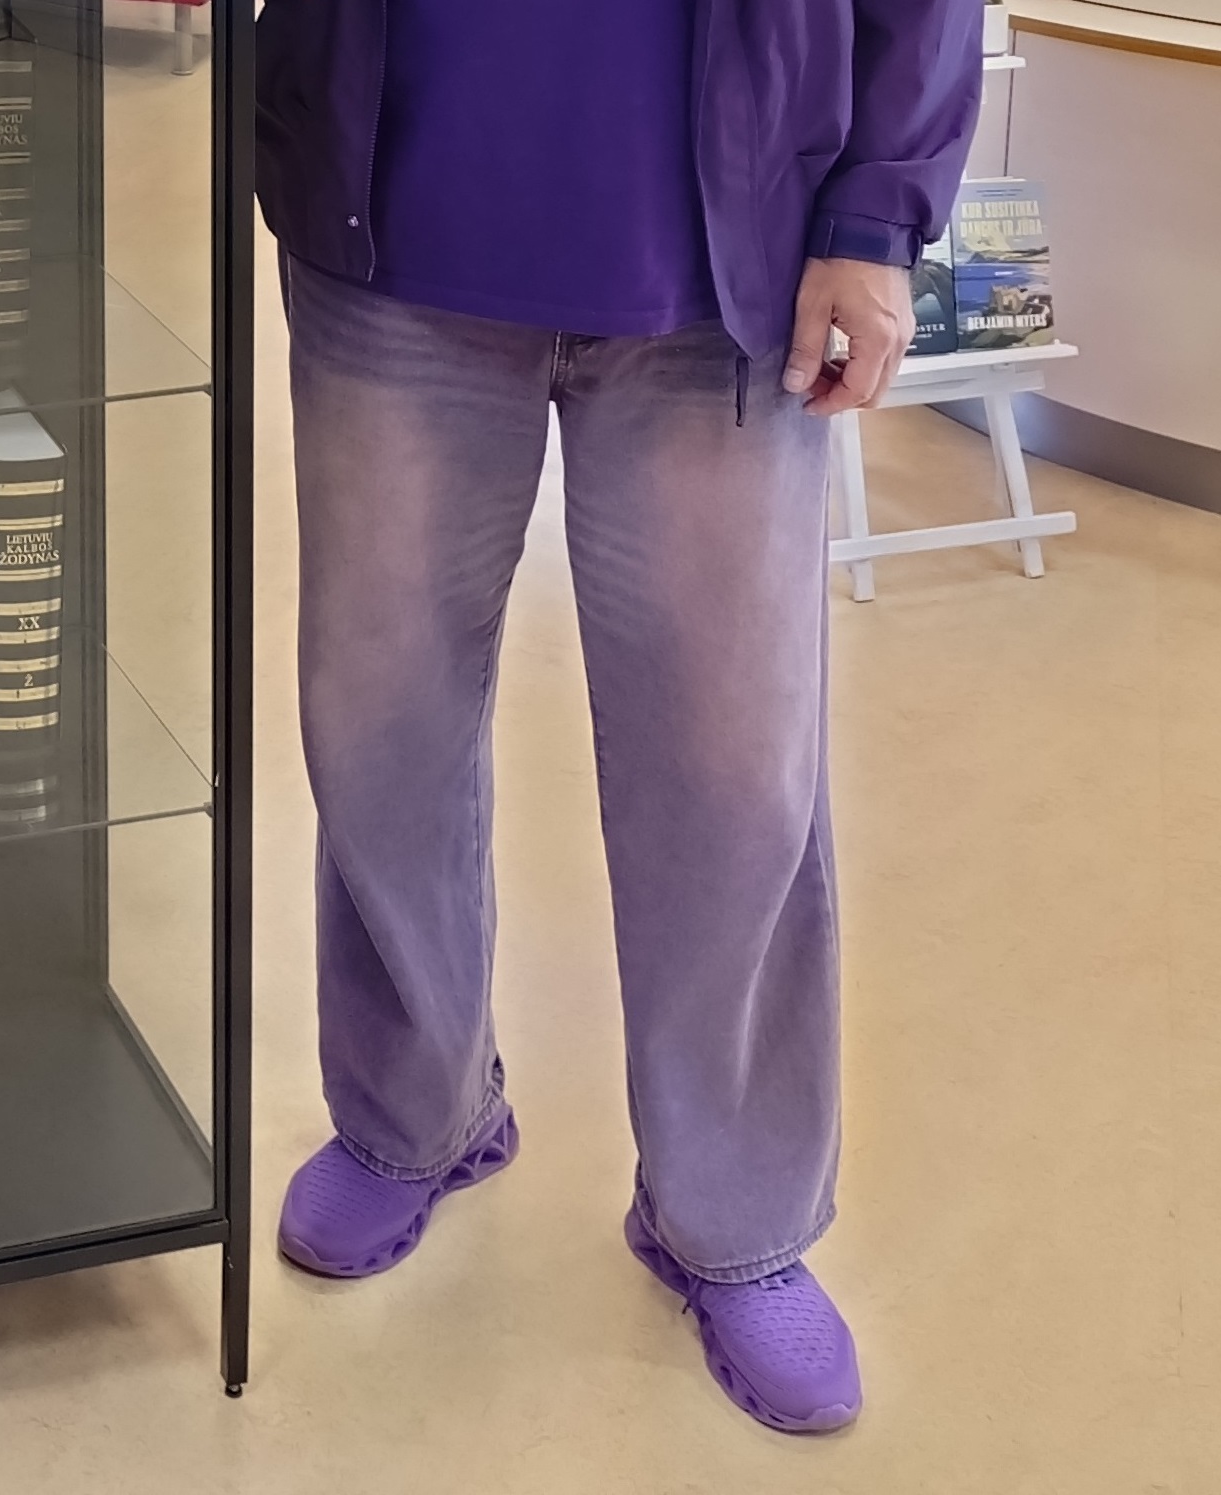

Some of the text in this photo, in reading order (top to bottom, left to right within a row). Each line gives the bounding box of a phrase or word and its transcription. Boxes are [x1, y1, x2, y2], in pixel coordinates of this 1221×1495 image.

[967, 313, 1047, 330] BENJAMIN MYERS
[7, 542, 53, 554] KALBOS
[0, 550, 60, 566] ŽODYNAS
[18, 616, 40, 630] XX
